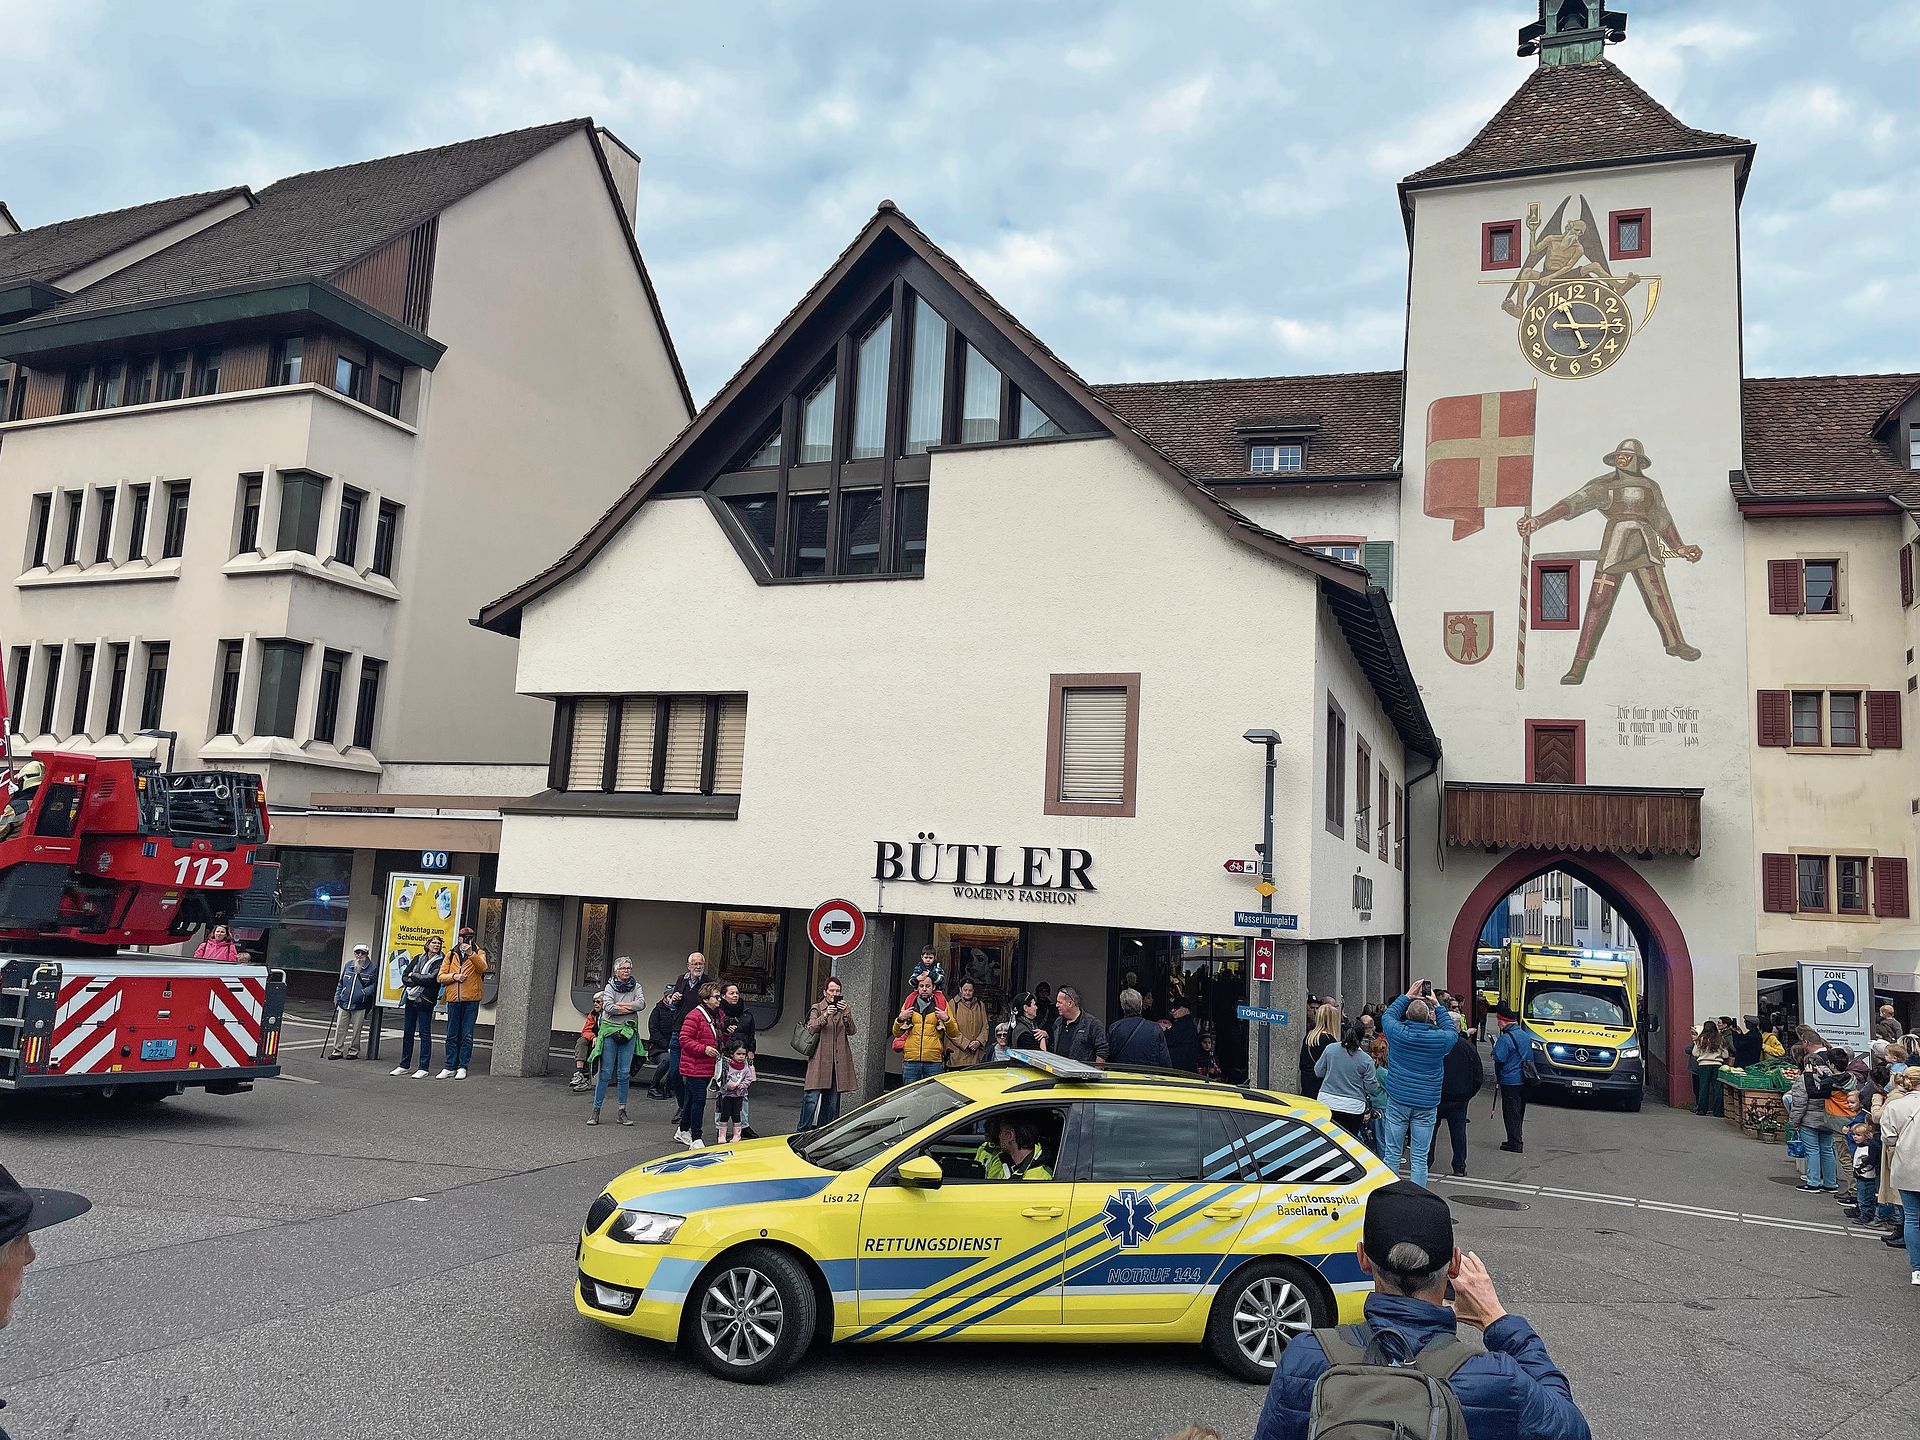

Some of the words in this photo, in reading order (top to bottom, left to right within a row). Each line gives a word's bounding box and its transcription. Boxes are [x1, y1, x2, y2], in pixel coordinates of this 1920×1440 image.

[1547, 290, 1559, 309] 11
[1566, 284, 1586, 301] 12
[1592, 287, 1600, 304] 1
[1604, 297, 1620, 314] 2
[1529, 306, 1546, 322] 10
[1526, 323, 1538, 340] 9
[1611, 318, 1624, 334] 3
[1532, 342, 1543, 359] 8
[1603, 337, 1619, 354] 4
[1545, 355, 1558, 372] 7
[1569, 359, 1581, 375] 6
[1590, 351, 1603, 369] 5
[872, 831, 1098, 891] BÜTLER
[174, 856, 229, 887] 112
[953, 886, 1015, 900] WOMEN'S
[1019, 890, 1077, 904] FASHION
[1237, 912, 1295, 928] Wasserturmplatz
[399, 925, 431, 935] Waschtag
[1824, 971, 1846, 980] ZONE
[36, 991, 55, 999] 5-31
[1544, 1028, 1619, 1039] AMBULANCE
[823, 1194, 844, 1203] Lisa
[846, 1194, 860, 1202] 22
[1286, 1193, 1360, 1205] Kantonsspital
[1277, 1205, 1329, 1216] Baselland
[864, 1237, 1003, 1252] RETTUNGSDIENST
[1107, 1268, 1171, 1283] NOTRUF
[1173, 1267, 1201, 1283] 144
